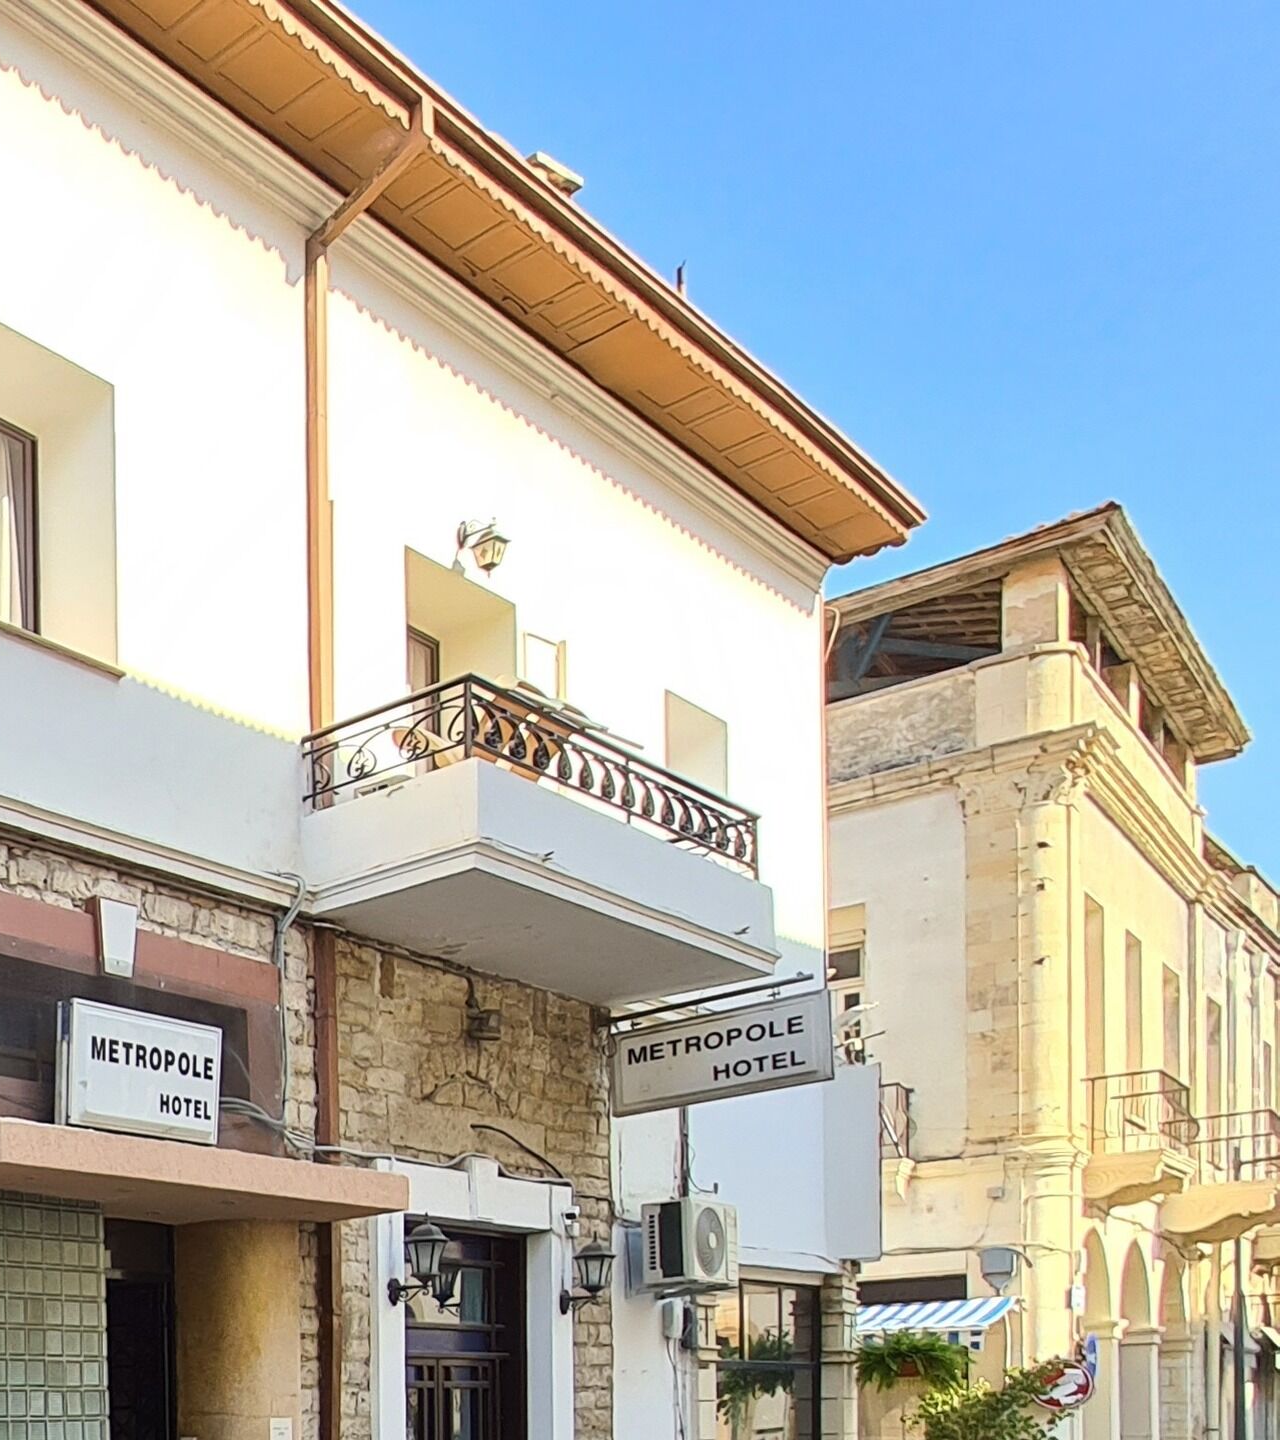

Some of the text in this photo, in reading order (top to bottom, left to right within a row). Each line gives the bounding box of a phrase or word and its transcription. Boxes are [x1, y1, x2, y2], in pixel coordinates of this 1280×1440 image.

[91, 1036, 214, 1081] METROPOLE
[627, 1015, 804, 1066] METROPOLE
[712, 1050, 806, 1081] HOTEL
[160, 1093, 212, 1121] HOTEL
